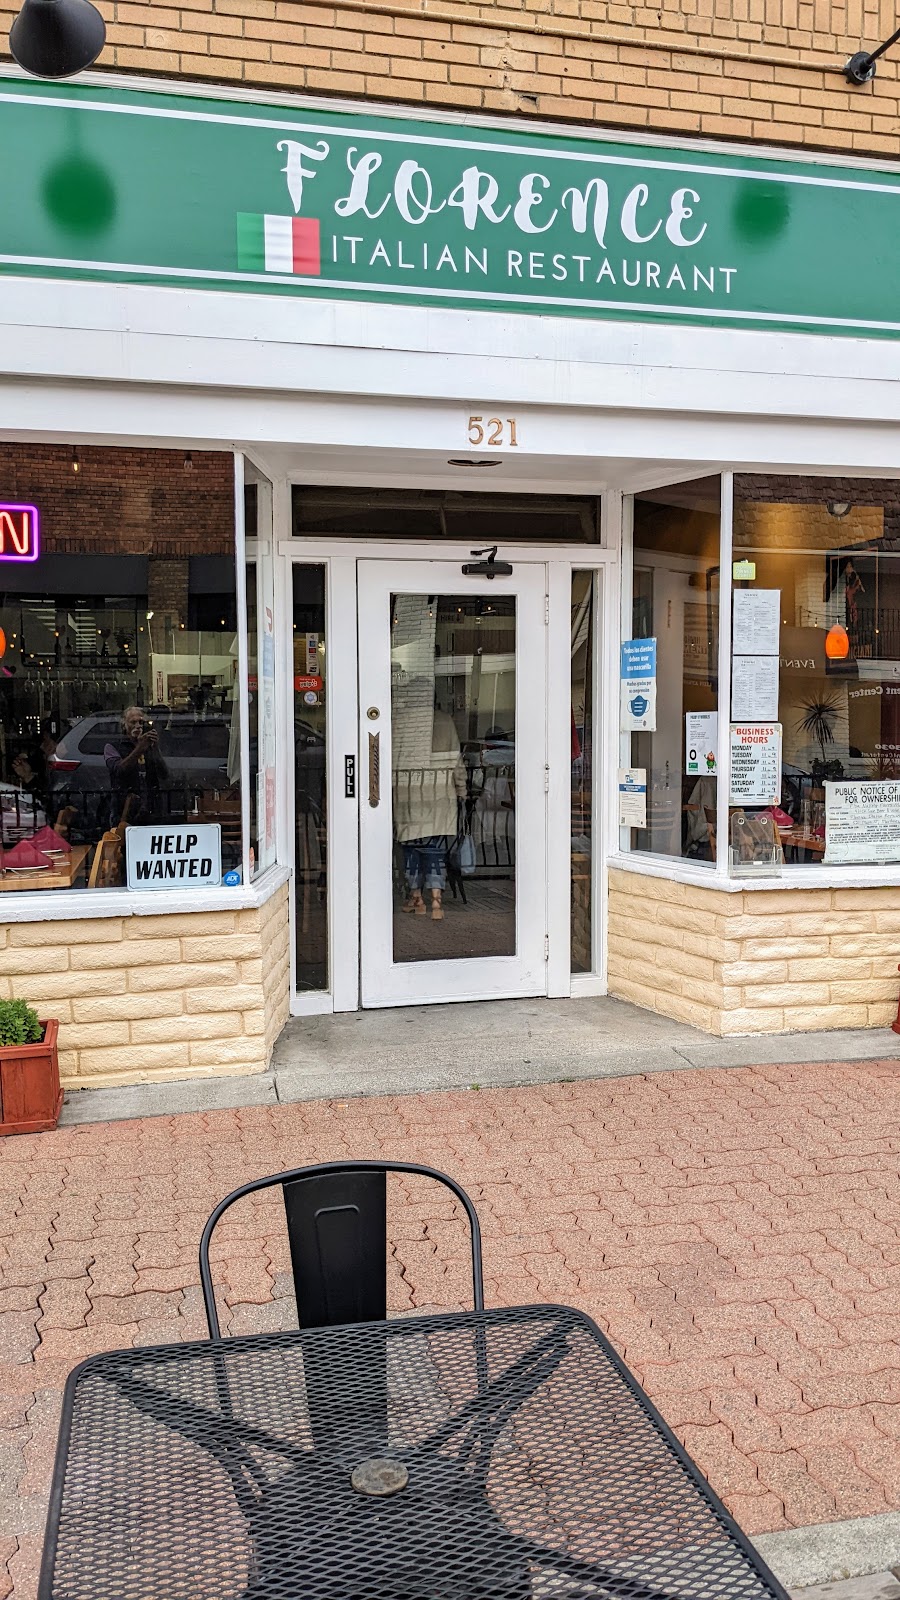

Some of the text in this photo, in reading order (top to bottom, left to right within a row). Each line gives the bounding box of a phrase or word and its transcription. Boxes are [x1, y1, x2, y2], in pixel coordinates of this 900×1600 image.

[277, 139, 708, 249] FLORENCE
[333, 235, 738, 294] ITALIAN RESTAURANT
[468, 416, 518, 446] 521
[346, 759, 354, 794] PULL
[835, 786, 898, 796] PUBLIC NOTICE OF
[845, 795, 900, 804] FOR OWNERSHI
[150, 834, 198, 855] HELP
[136, 858, 212, 880] WANTED
